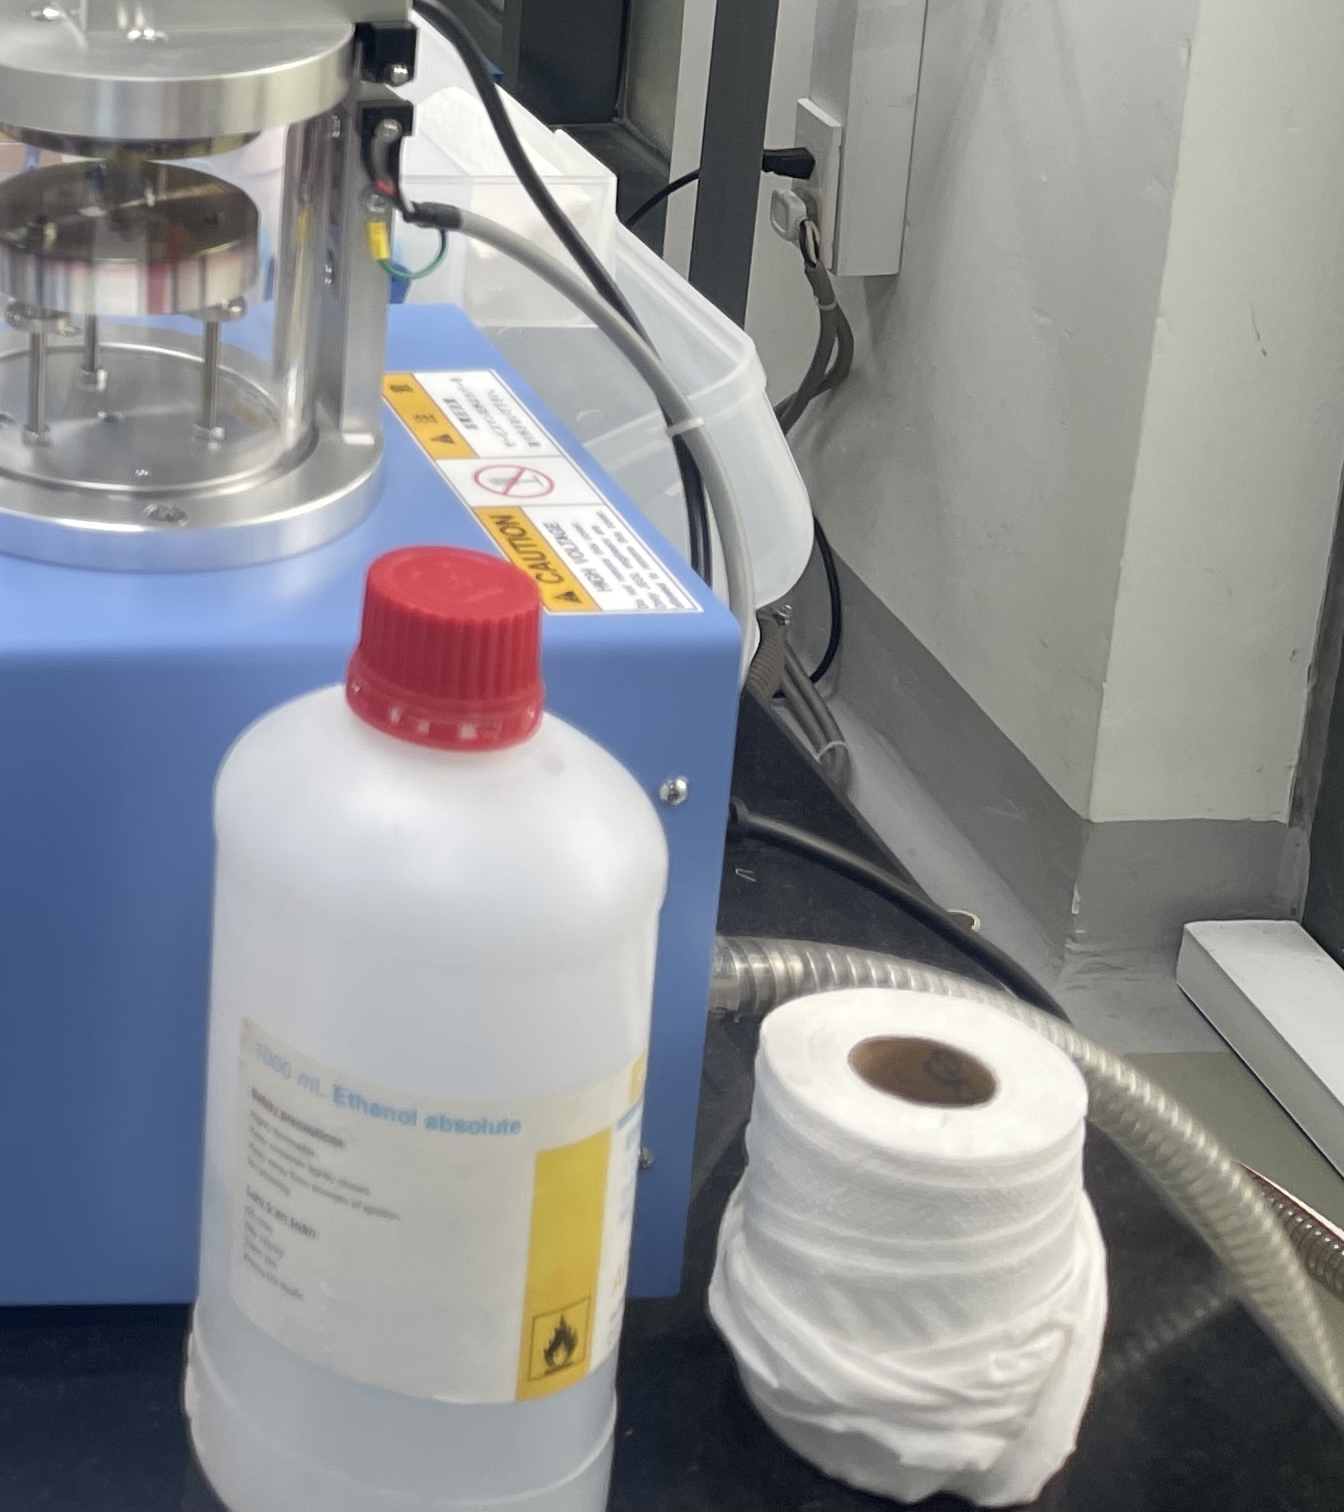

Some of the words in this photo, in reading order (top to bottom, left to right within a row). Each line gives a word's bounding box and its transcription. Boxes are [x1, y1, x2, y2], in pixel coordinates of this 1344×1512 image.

[489, 514, 565, 585] CAUTION
[543, 522, 589, 564] VOLTAGE
[581, 568, 613, 592] HIGH
[332, 1084, 418, 1128] Ethanol
[424, 1114, 523, 1135] absolute
